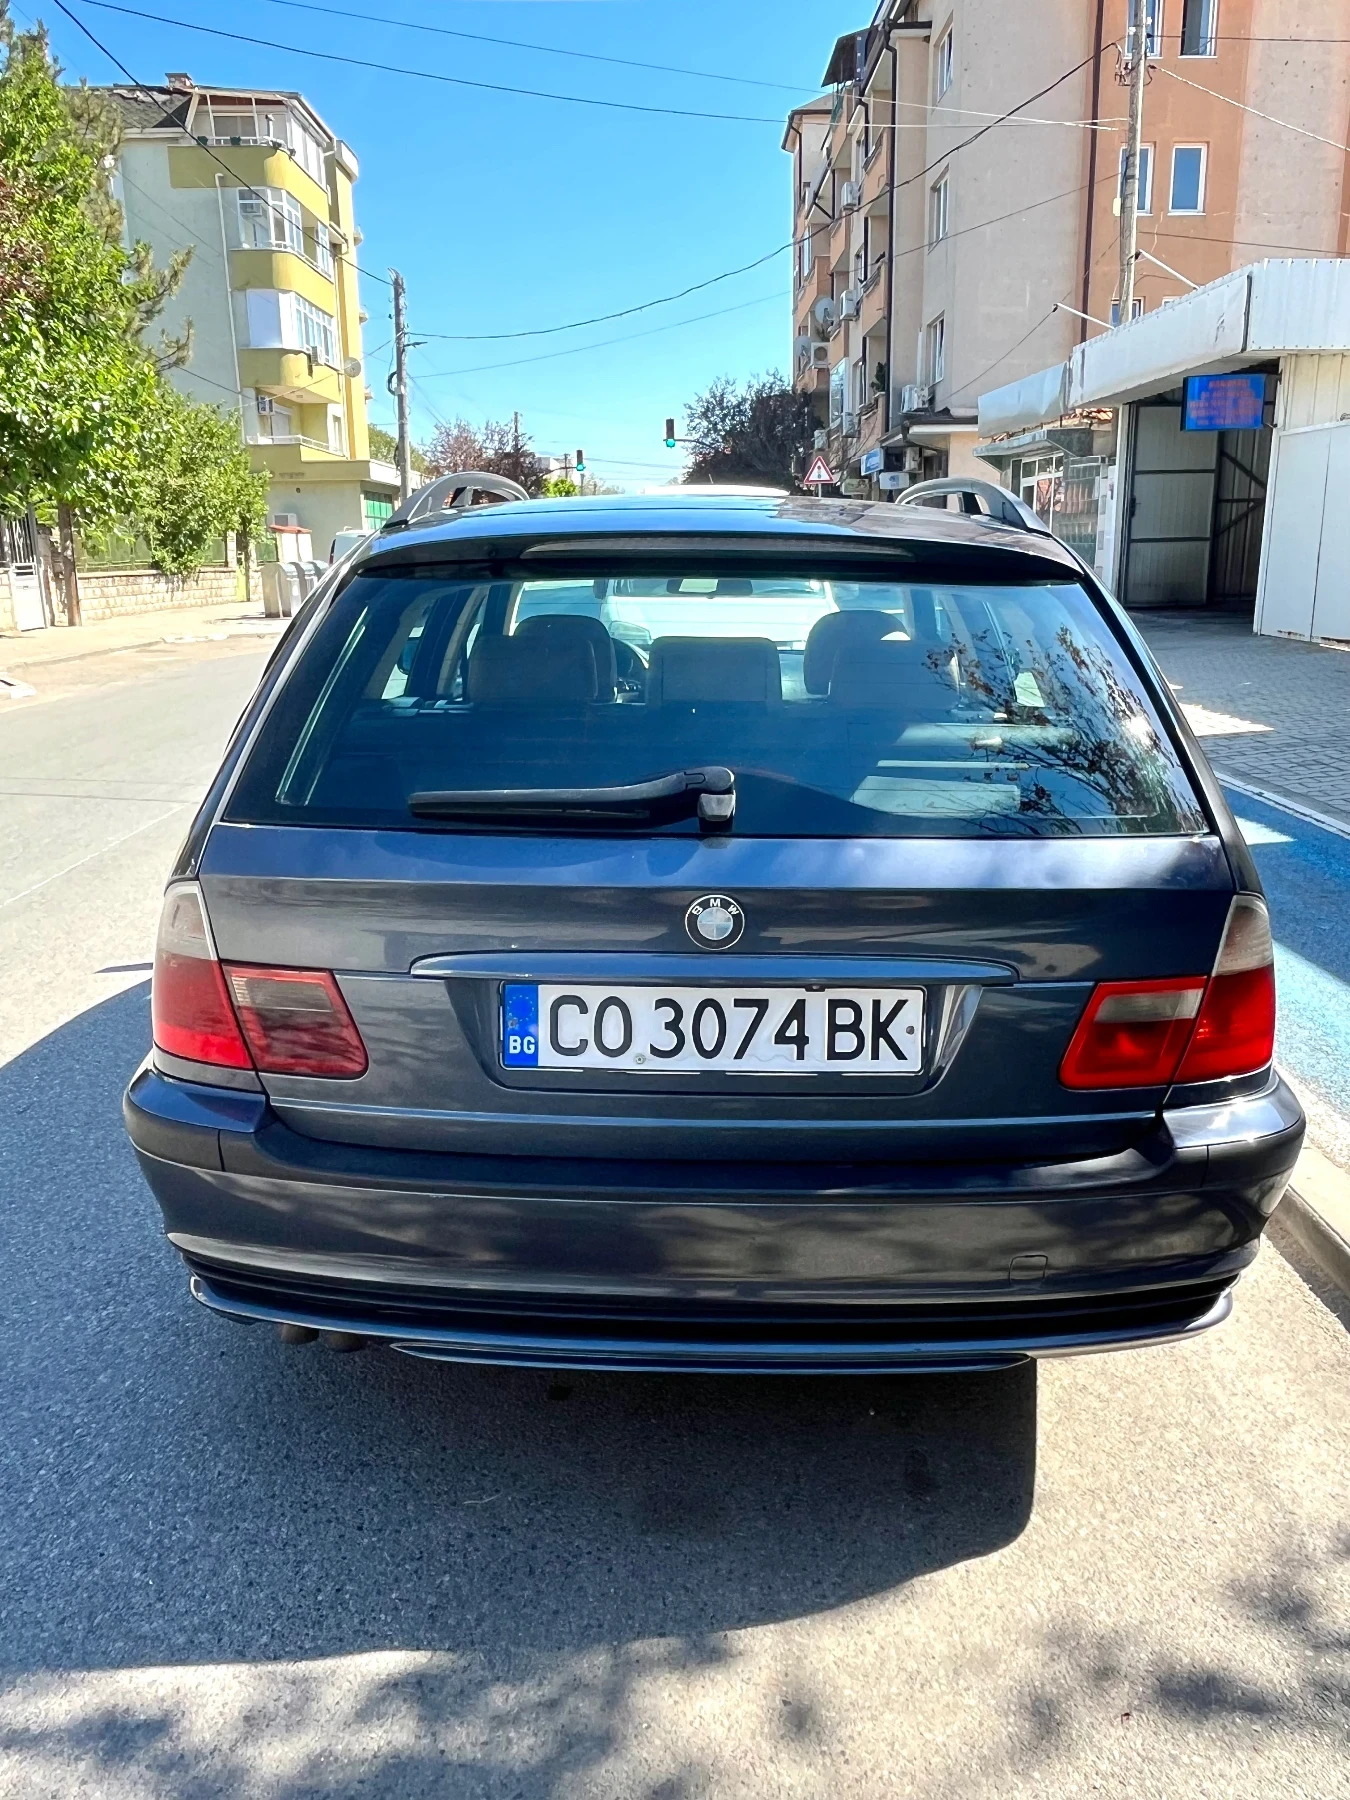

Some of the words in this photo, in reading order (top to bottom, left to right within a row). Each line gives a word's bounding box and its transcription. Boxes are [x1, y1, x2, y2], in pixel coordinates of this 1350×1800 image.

[691, 898, 740, 916] BMW
[550, 994, 633, 1058] CO
[650, 997, 809, 1061] 3074
[827, 998, 909, 1061] BK
[509, 1035, 536, 1055] BG
